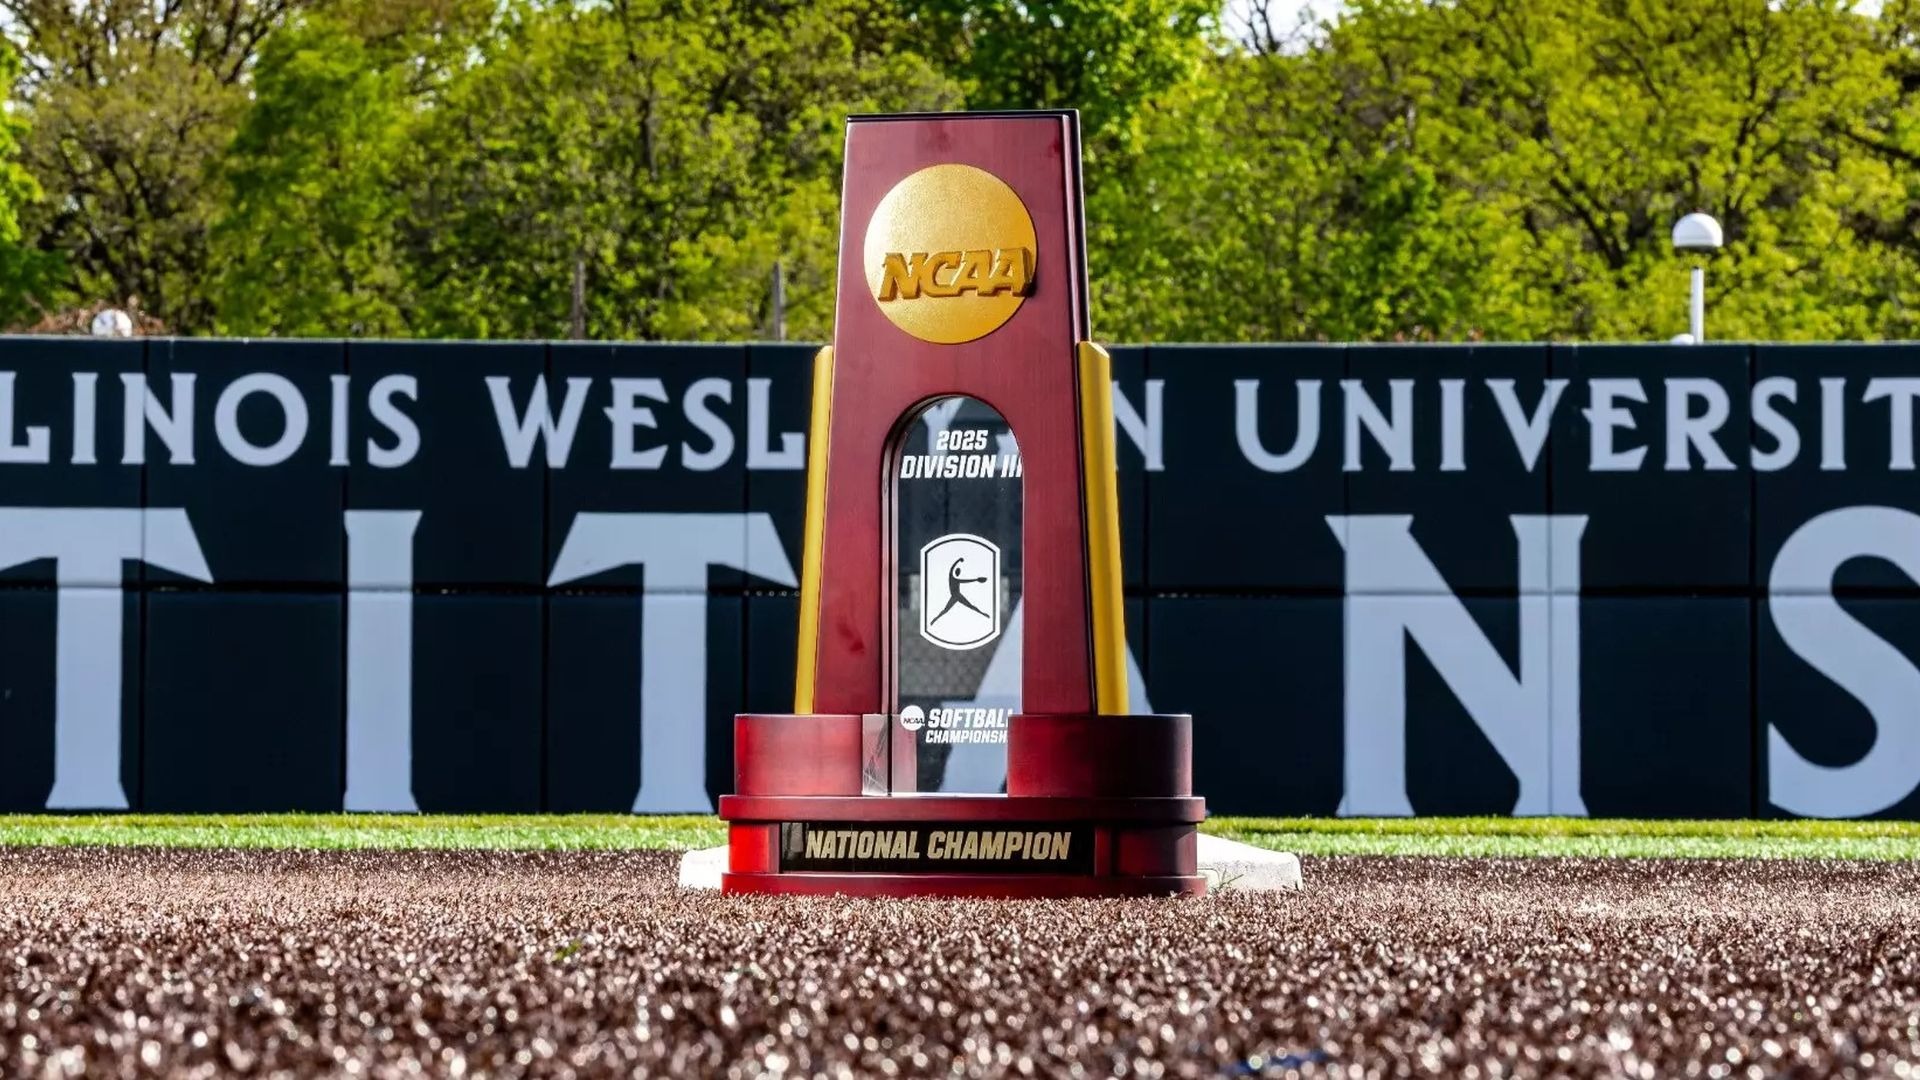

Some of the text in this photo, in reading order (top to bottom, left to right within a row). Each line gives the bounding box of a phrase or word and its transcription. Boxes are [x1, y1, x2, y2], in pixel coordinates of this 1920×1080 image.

[878, 247, 1035, 302] NCAA
[0, 371, 421, 468] LINOIS
[1233, 375, 1920, 472] UNIVERSIT
[935, 429, 989, 451] 2025
[900, 454, 996, 479] DIVISION
[925, 729, 1009, 744] CHAMPIONSH
[805, 830, 1072, 860] NATIONAL CHAMPION
